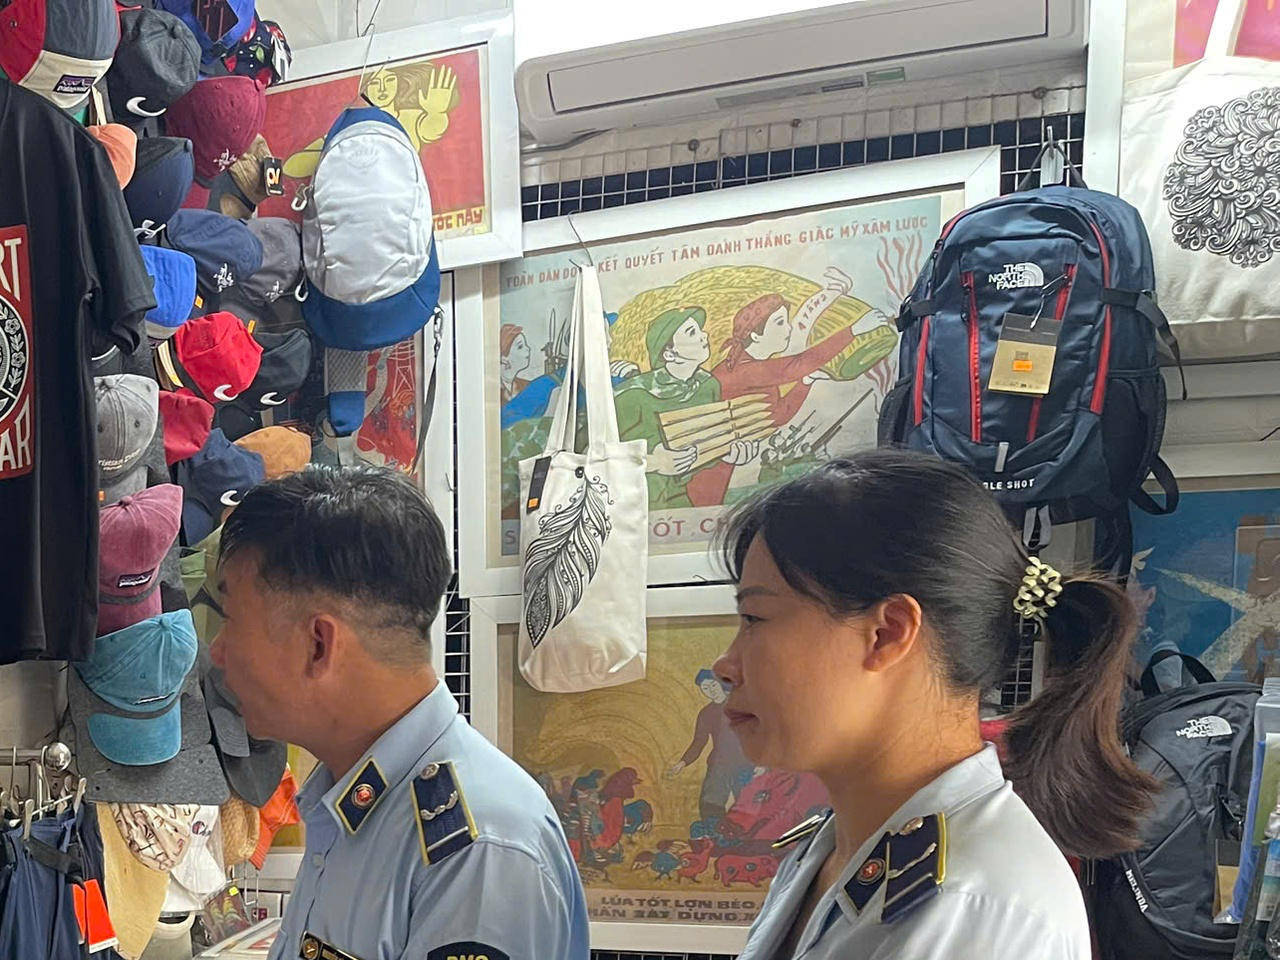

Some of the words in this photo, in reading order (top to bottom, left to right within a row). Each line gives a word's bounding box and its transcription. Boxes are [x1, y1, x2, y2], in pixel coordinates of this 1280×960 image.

[1002, 263, 1025, 272] THE
[988, 271, 1025, 284] NORTH
[996, 280, 1025, 291] FACE
[1006, 478, 1036, 490] SHOT
[1186, 717, 1210, 728] THE
